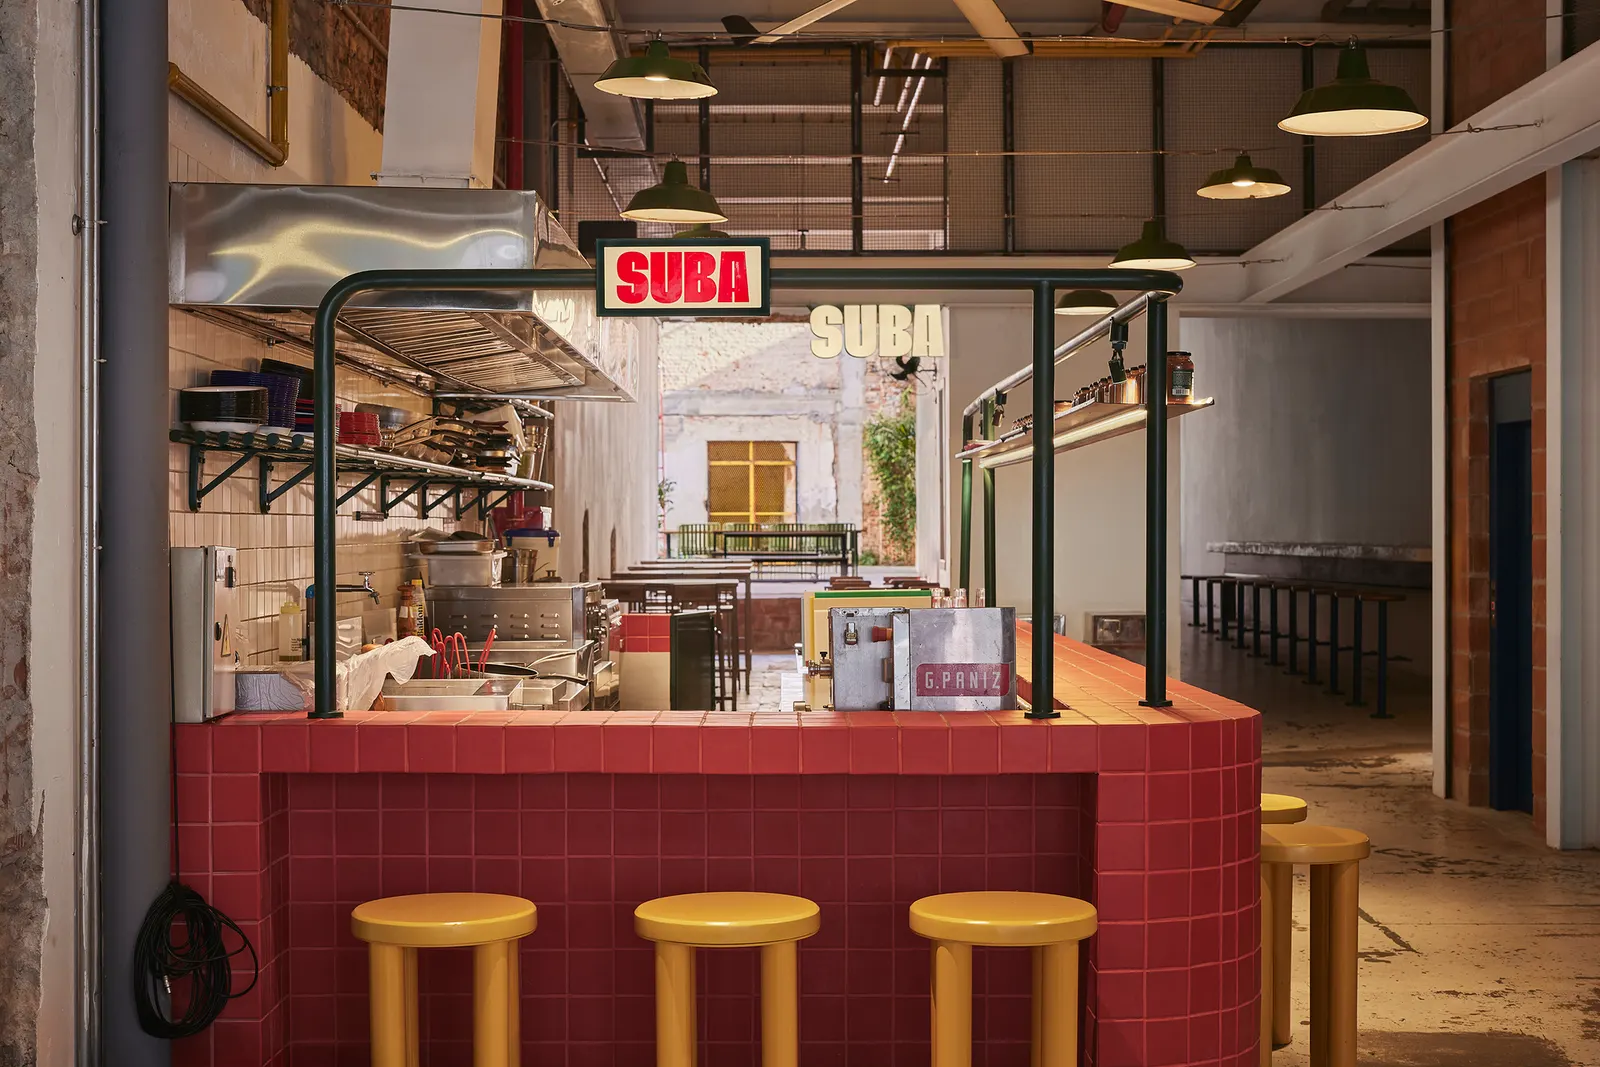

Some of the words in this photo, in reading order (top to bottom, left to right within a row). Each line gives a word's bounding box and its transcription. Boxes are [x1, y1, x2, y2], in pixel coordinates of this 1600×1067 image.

[616, 251, 750, 304] SUBA
[810, 304, 944, 358] SUBA
[925, 671, 1001, 689] G.PANIZ
